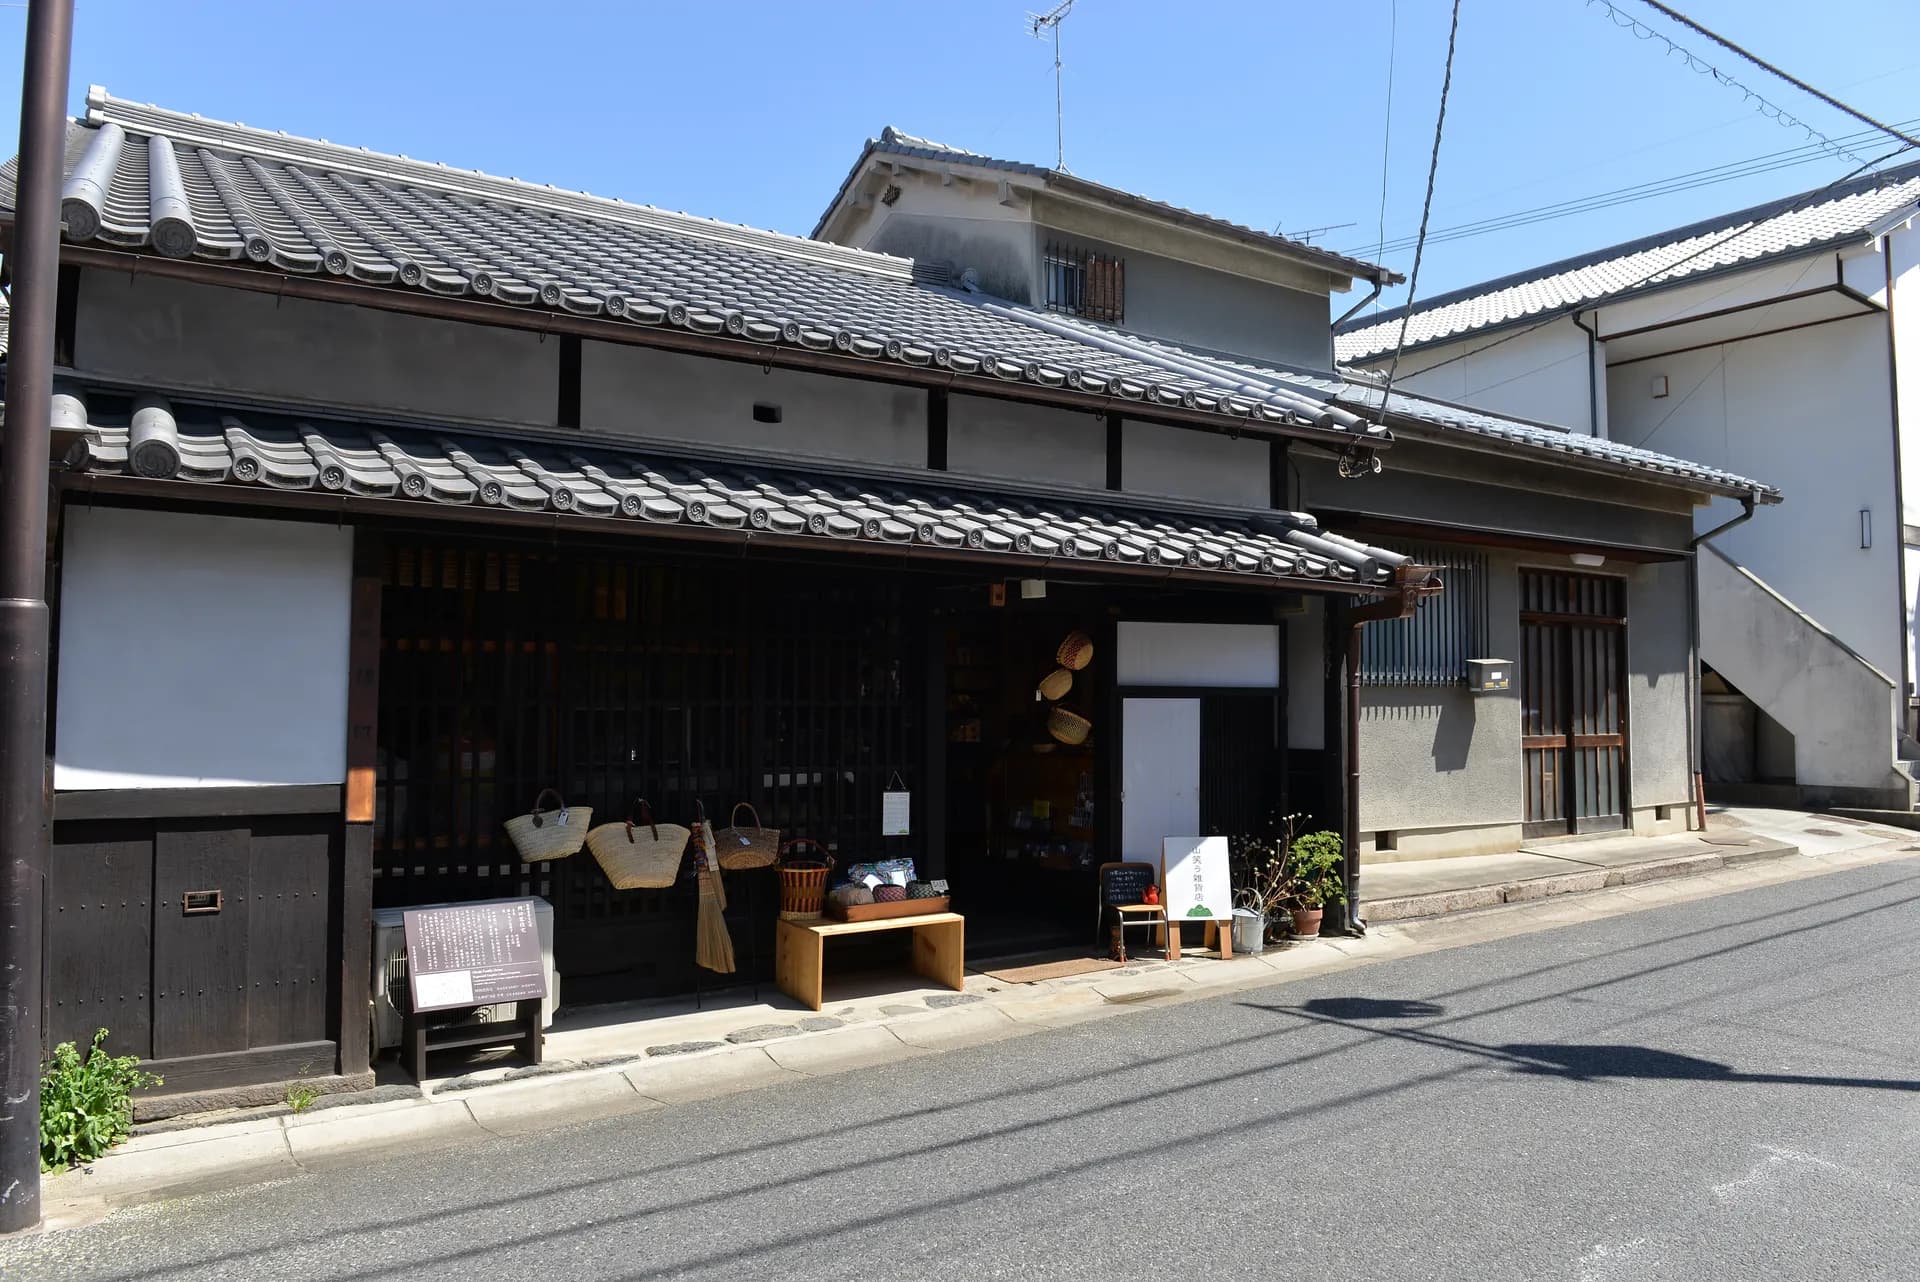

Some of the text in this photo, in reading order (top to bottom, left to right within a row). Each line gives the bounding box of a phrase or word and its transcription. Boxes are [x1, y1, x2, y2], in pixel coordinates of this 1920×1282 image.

[1192, 847, 1204, 901] 山笑う雑貨店
